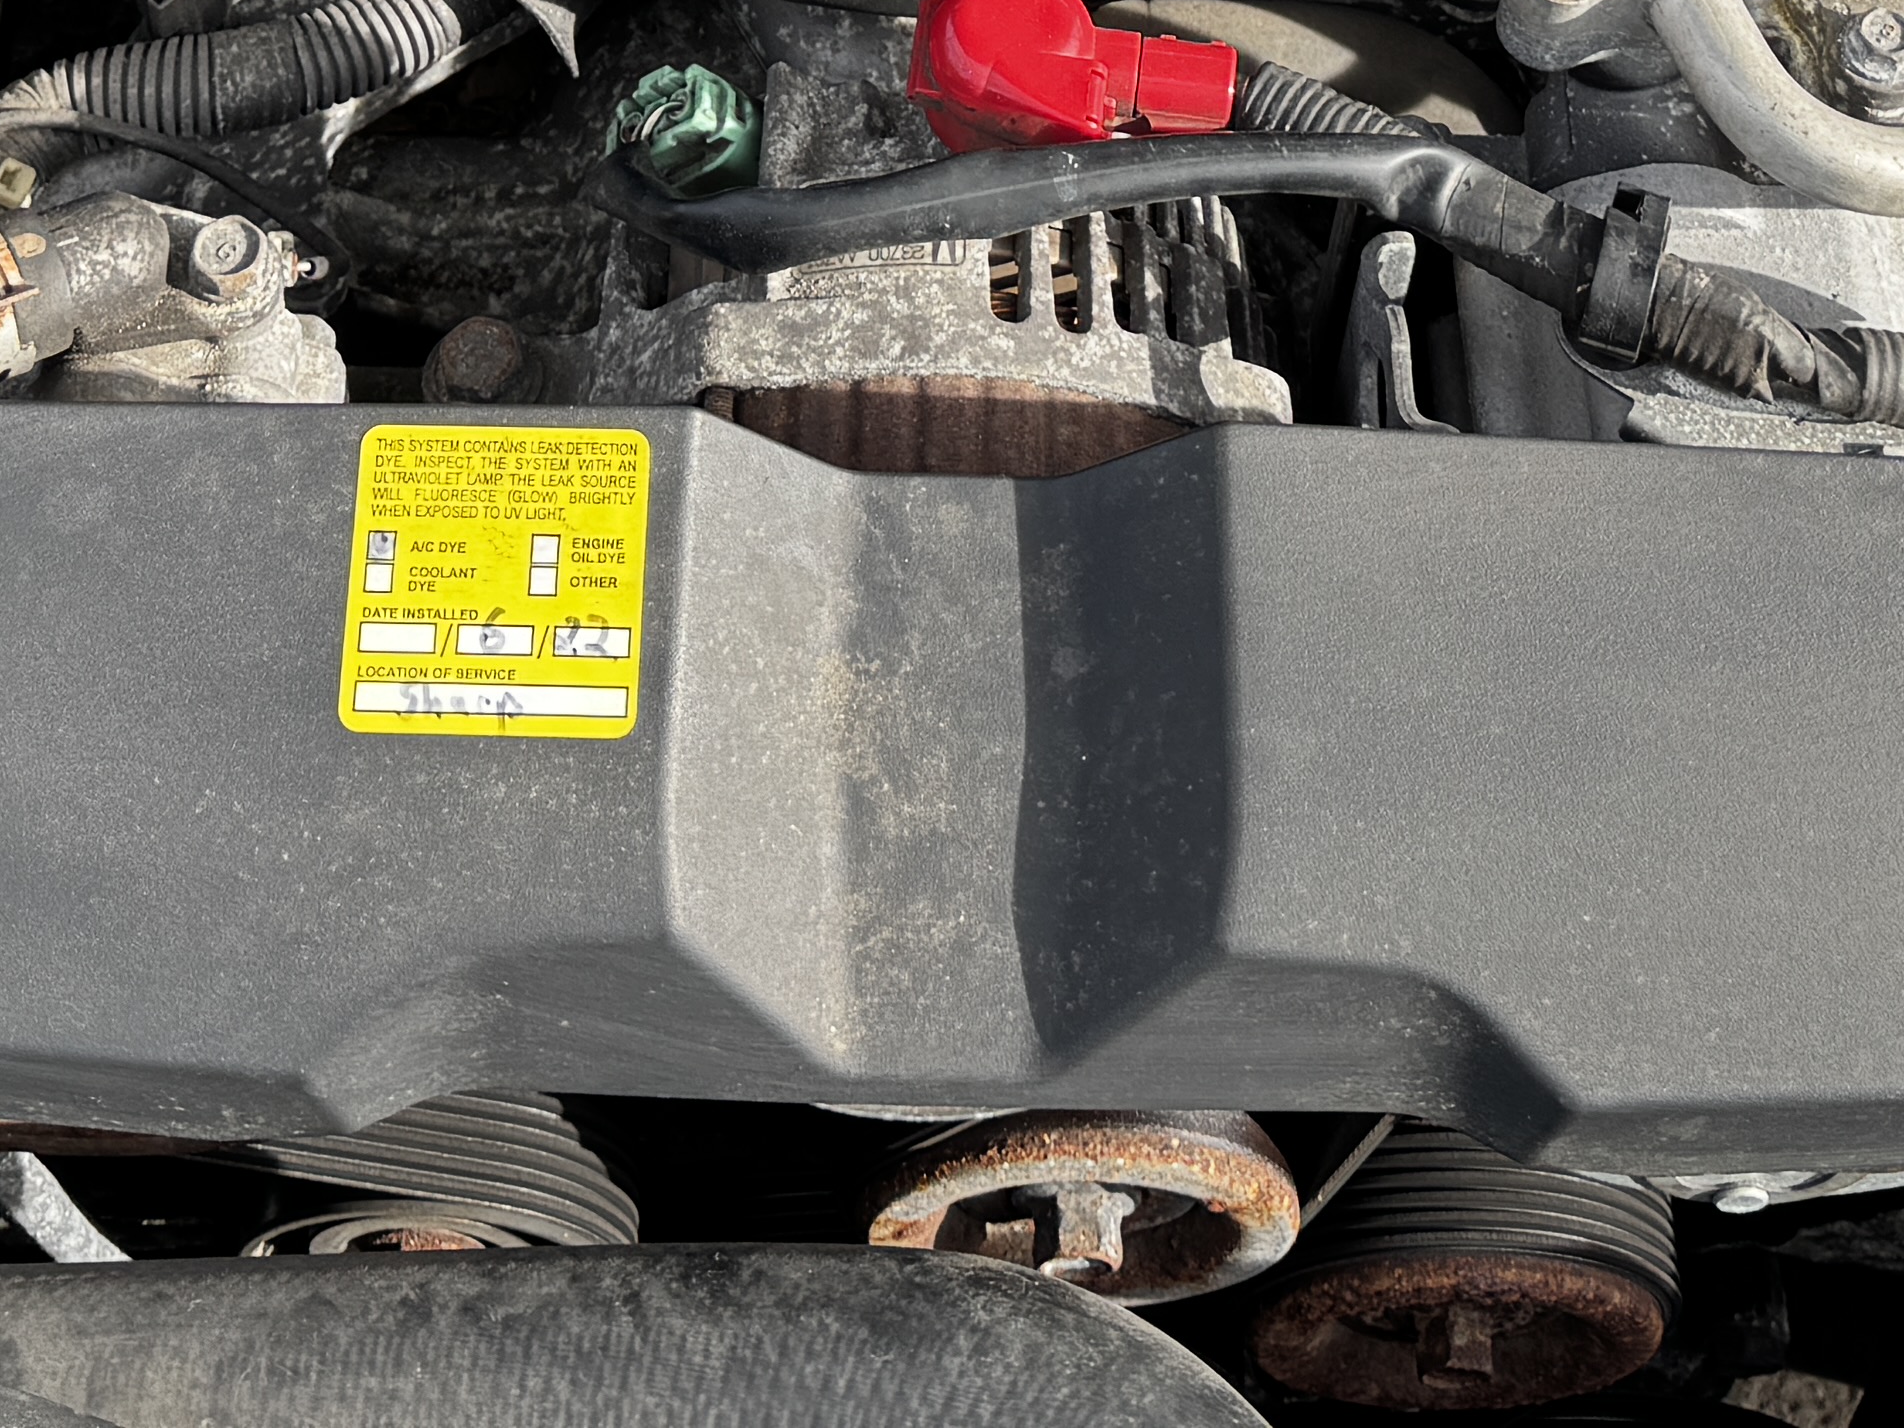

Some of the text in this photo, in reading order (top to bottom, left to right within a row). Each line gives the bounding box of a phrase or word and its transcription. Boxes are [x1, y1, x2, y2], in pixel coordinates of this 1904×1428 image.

[377, 438, 638, 455] THIS SYSTEM CONTAINS LEAK DETECTION
[481, 457, 507, 470] THE
[516, 458, 569, 471] SYSTEM
[578, 459, 611, 472] WITH
[619, 460, 637, 472] AN
[374, 472, 462, 485] ULTRAVIOLET
[511, 474, 535, 486] THE
[541, 475, 574, 486] LEAK
[580, 475, 636, 488] SOURCE
[372, 487, 636, 505] WILL FLUORESCE (GLOW) BRIGHTLY
[371, 504, 410, 517] WHEN
[416, 505, 478, 518] EXPOSED
[484, 506, 500, 519] TO
[505, 507, 522, 519] UV
[410, 541, 467, 554] A/C DYE
[571, 537, 625, 550] ENGINE
[571, 552, 626, 564] OIL DYE
[409, 566, 477, 579] COOLANT
[408, 580, 437, 592] DYE
[569, 576, 618, 588] OTHER
[362, 607, 478, 620] DATE INSTALLED
[357, 666, 516, 681] LOCATION OF SERVICE
